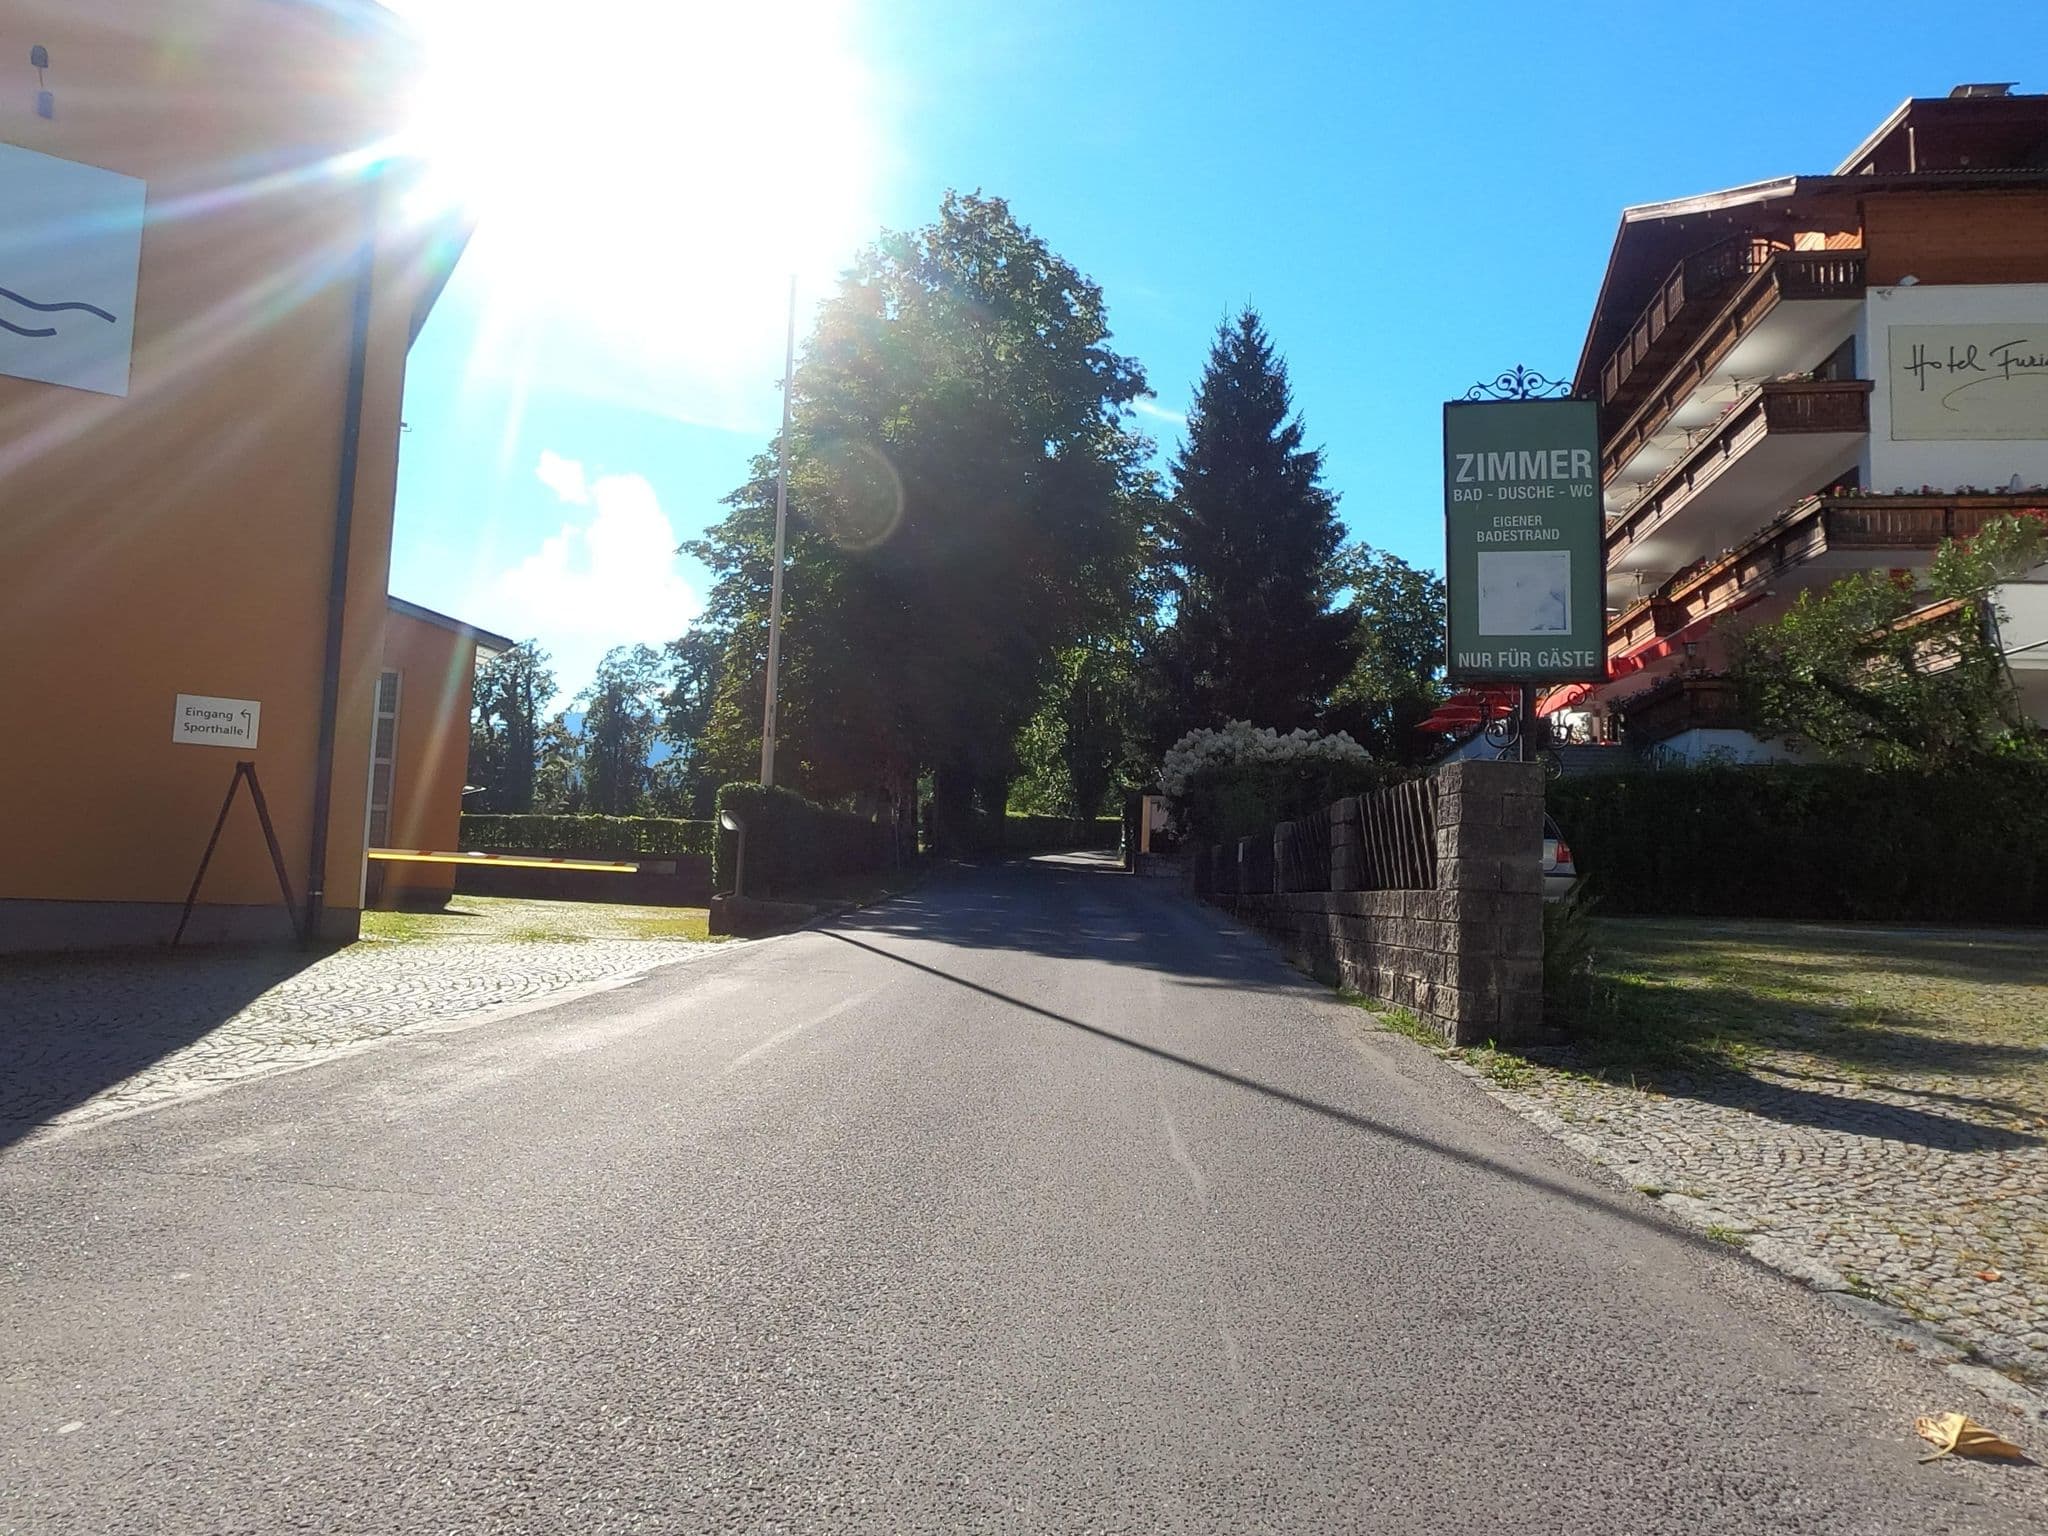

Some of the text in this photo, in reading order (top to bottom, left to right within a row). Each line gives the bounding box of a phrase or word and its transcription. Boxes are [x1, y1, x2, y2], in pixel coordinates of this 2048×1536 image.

[1904, 344, 1987, 391] Hotel
[1455, 449, 1593, 483] ZIMMER
[1453, 488, 1483, 502] BAD
[1498, 485, 1555, 501] DUSCHE
[1569, 484, 1593, 498] WC
[1493, 515, 1543, 528] EIGENER
[1476, 528, 1560, 543] BADESTRAND
[1458, 648, 1595, 668] NUR FÜR GÄSTE
[185, 706, 234, 722] Eingang
[183, 722, 244, 736] Sporthalle
